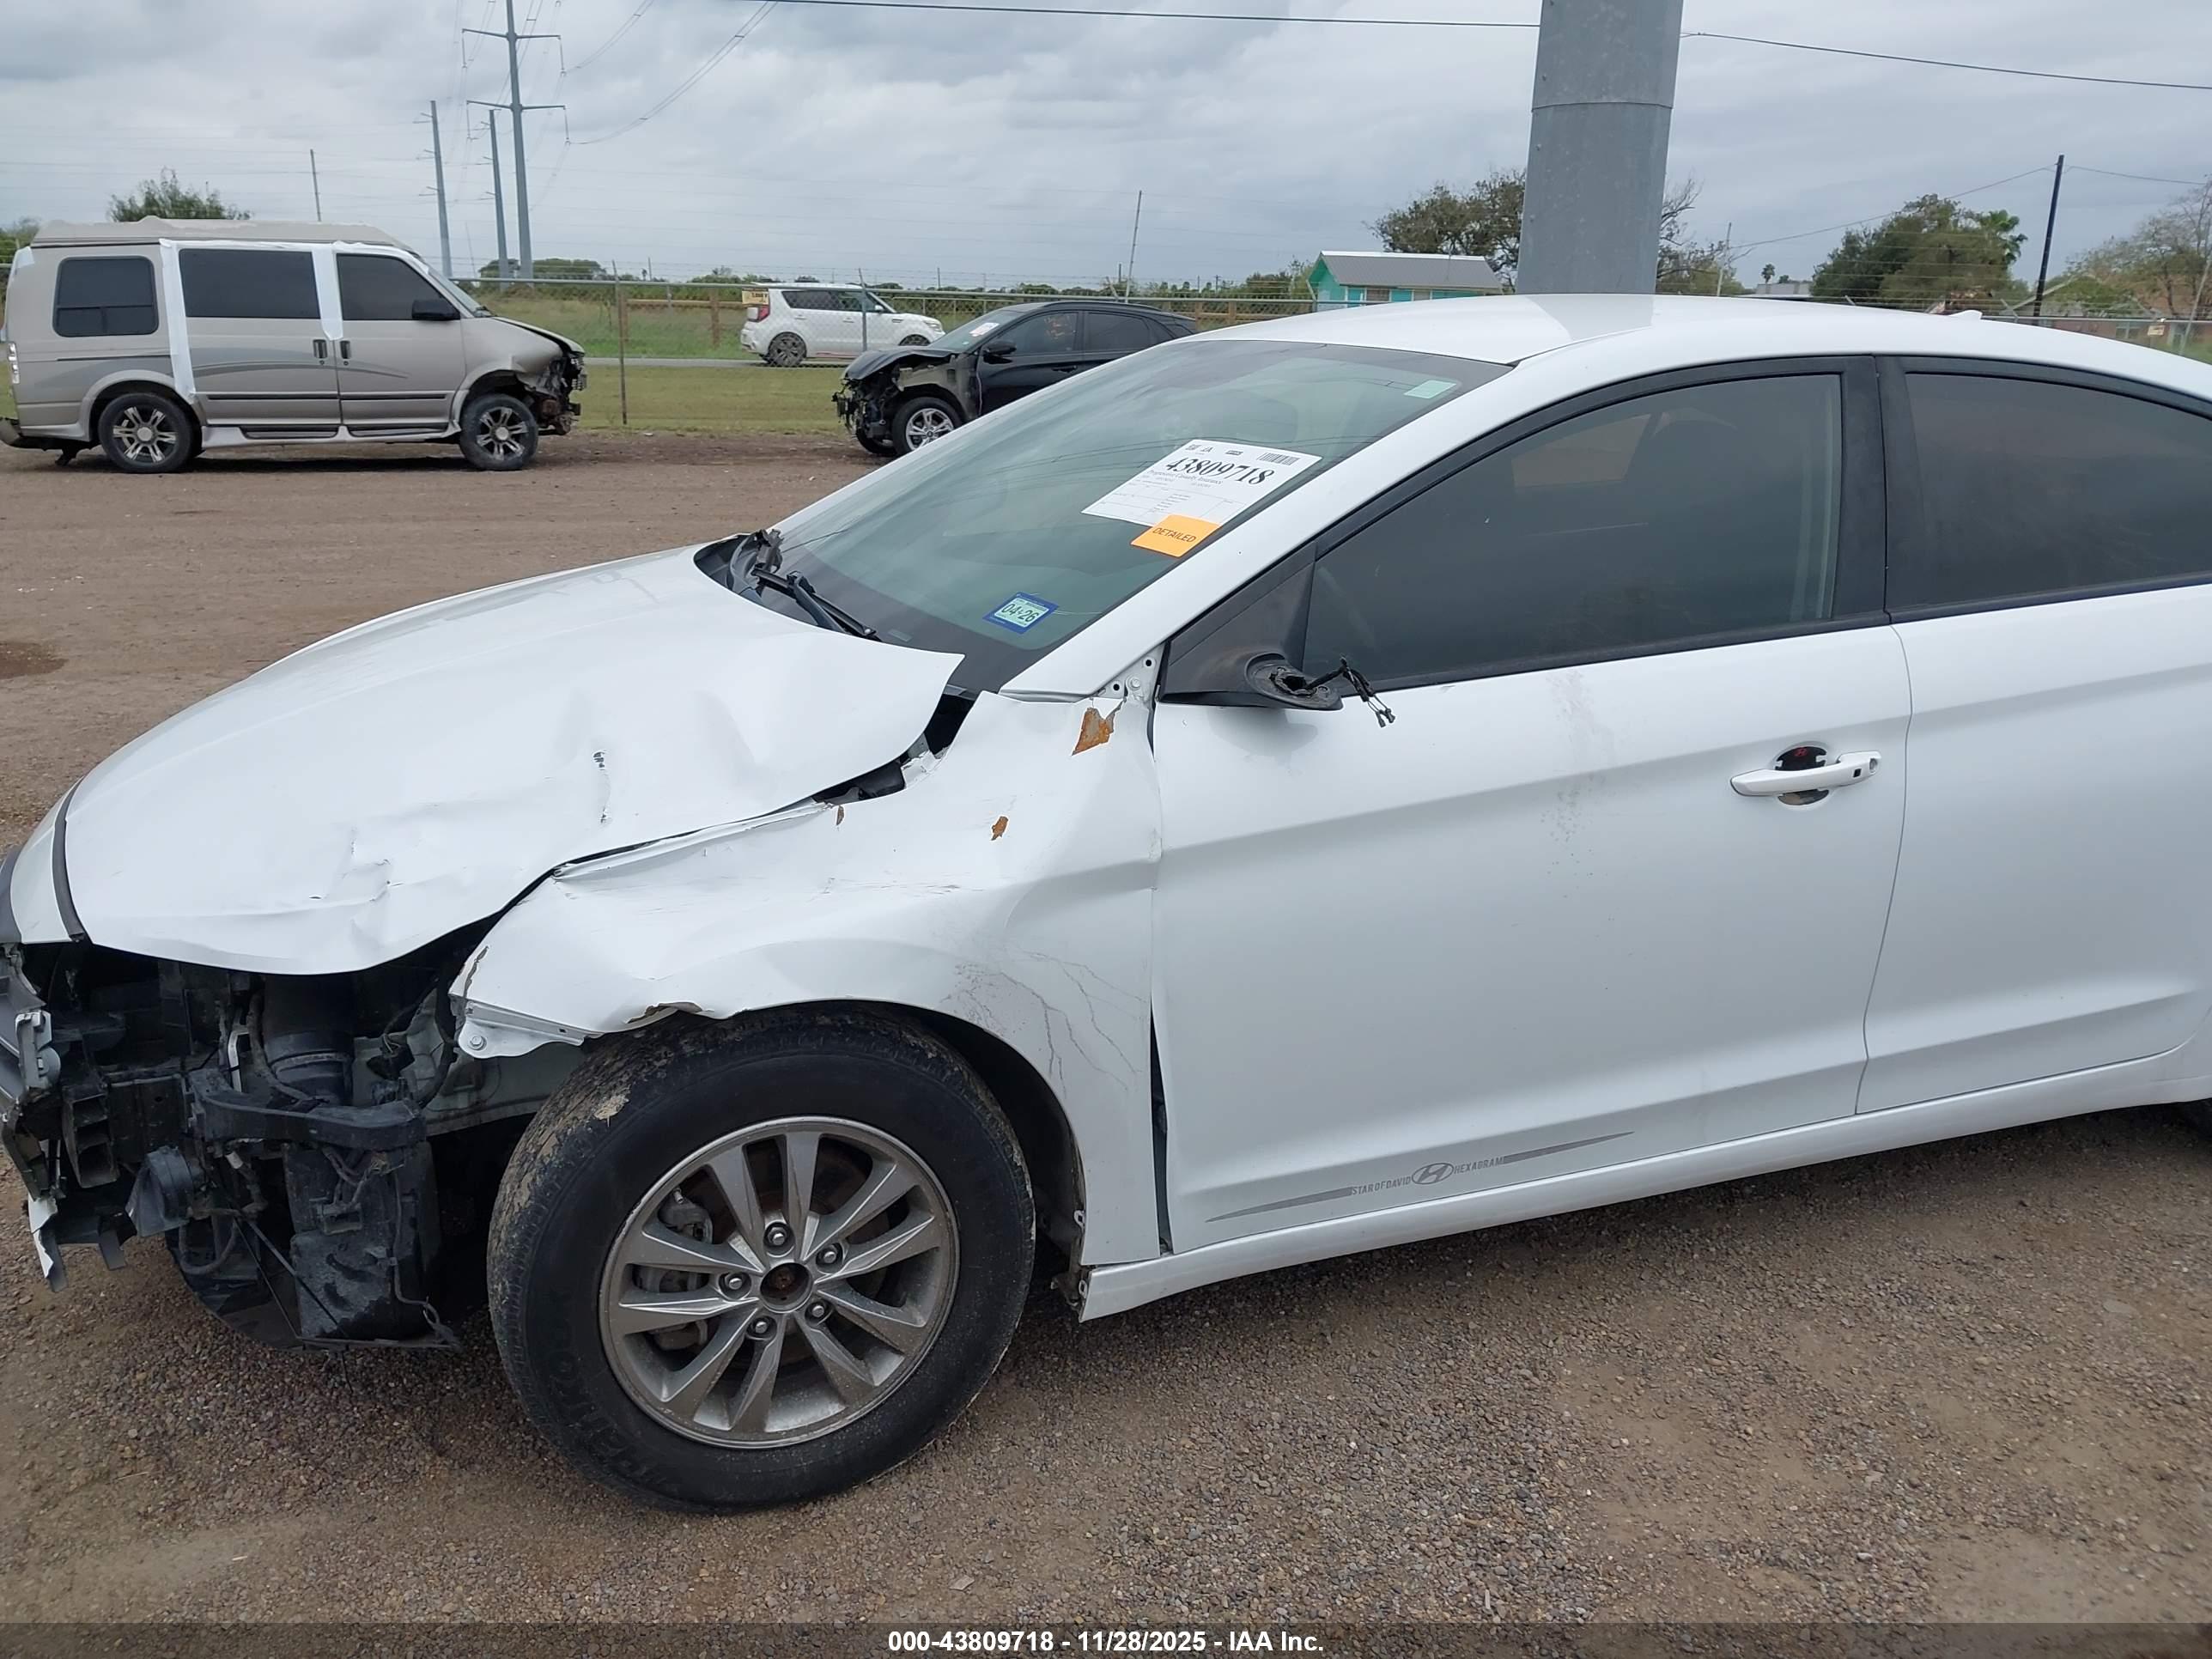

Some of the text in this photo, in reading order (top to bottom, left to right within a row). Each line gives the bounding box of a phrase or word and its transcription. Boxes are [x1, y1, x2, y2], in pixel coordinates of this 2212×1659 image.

[1166, 458, 1275, 485] 43809718
[1152, 526, 1196, 544] DETAILED
[1454, 1157, 1503, 1175] HEXAGRAM
